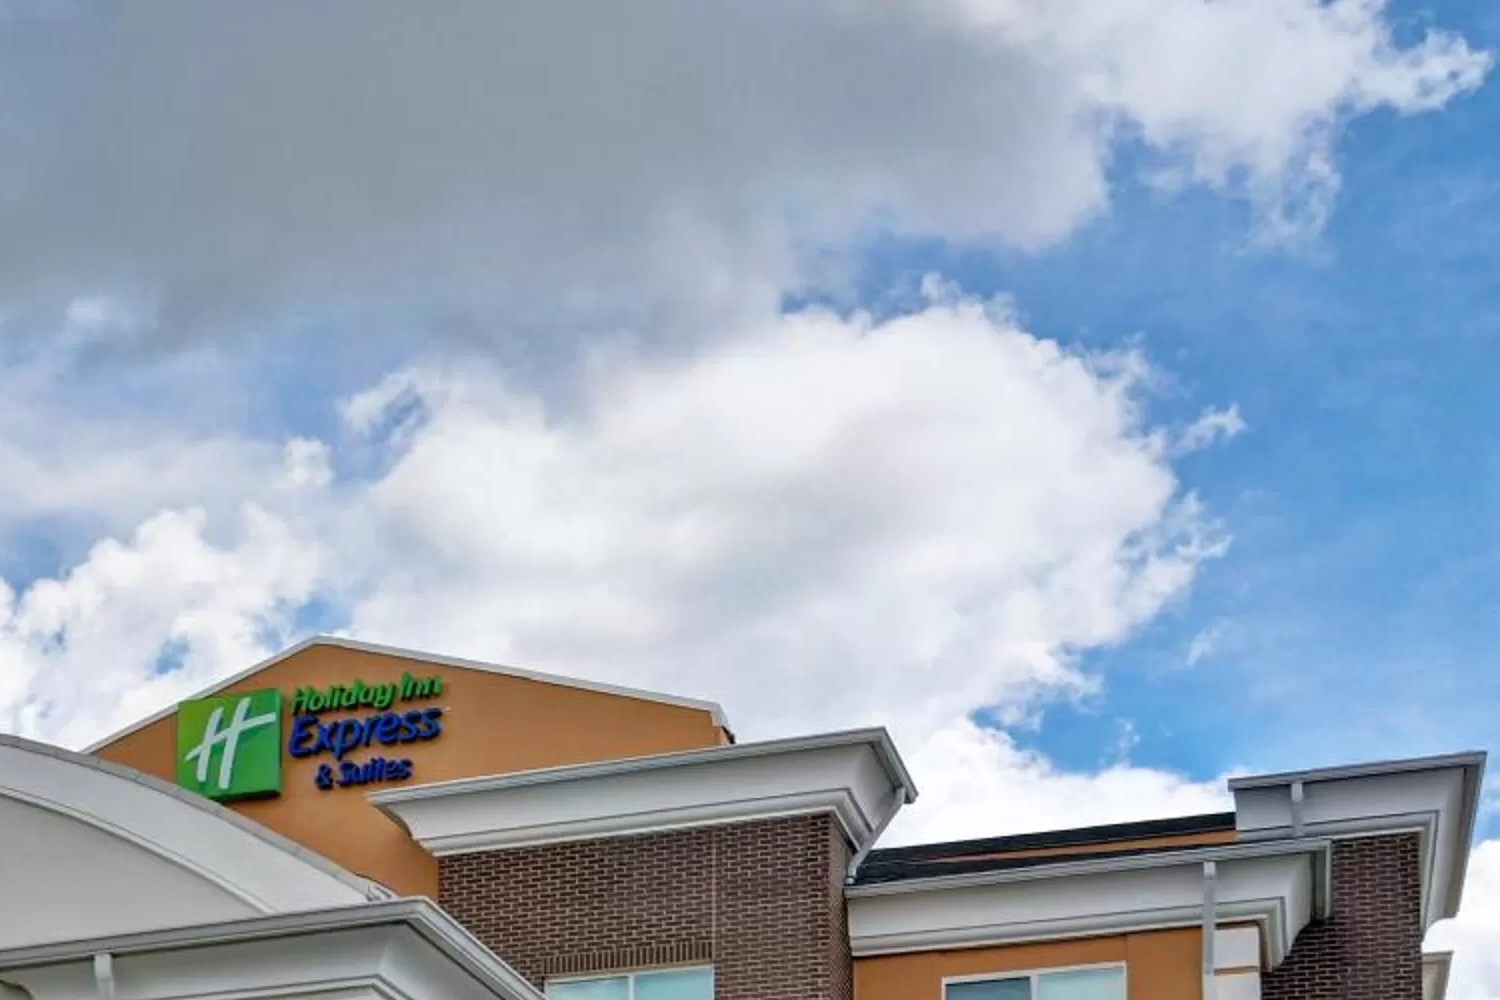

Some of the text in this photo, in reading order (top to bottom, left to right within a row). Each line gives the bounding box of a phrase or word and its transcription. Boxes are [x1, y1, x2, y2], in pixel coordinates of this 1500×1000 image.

[292, 672, 444, 712] Holiday Inn
[290, 709, 443, 760] Express
[315, 757, 413, 789] & Suites
